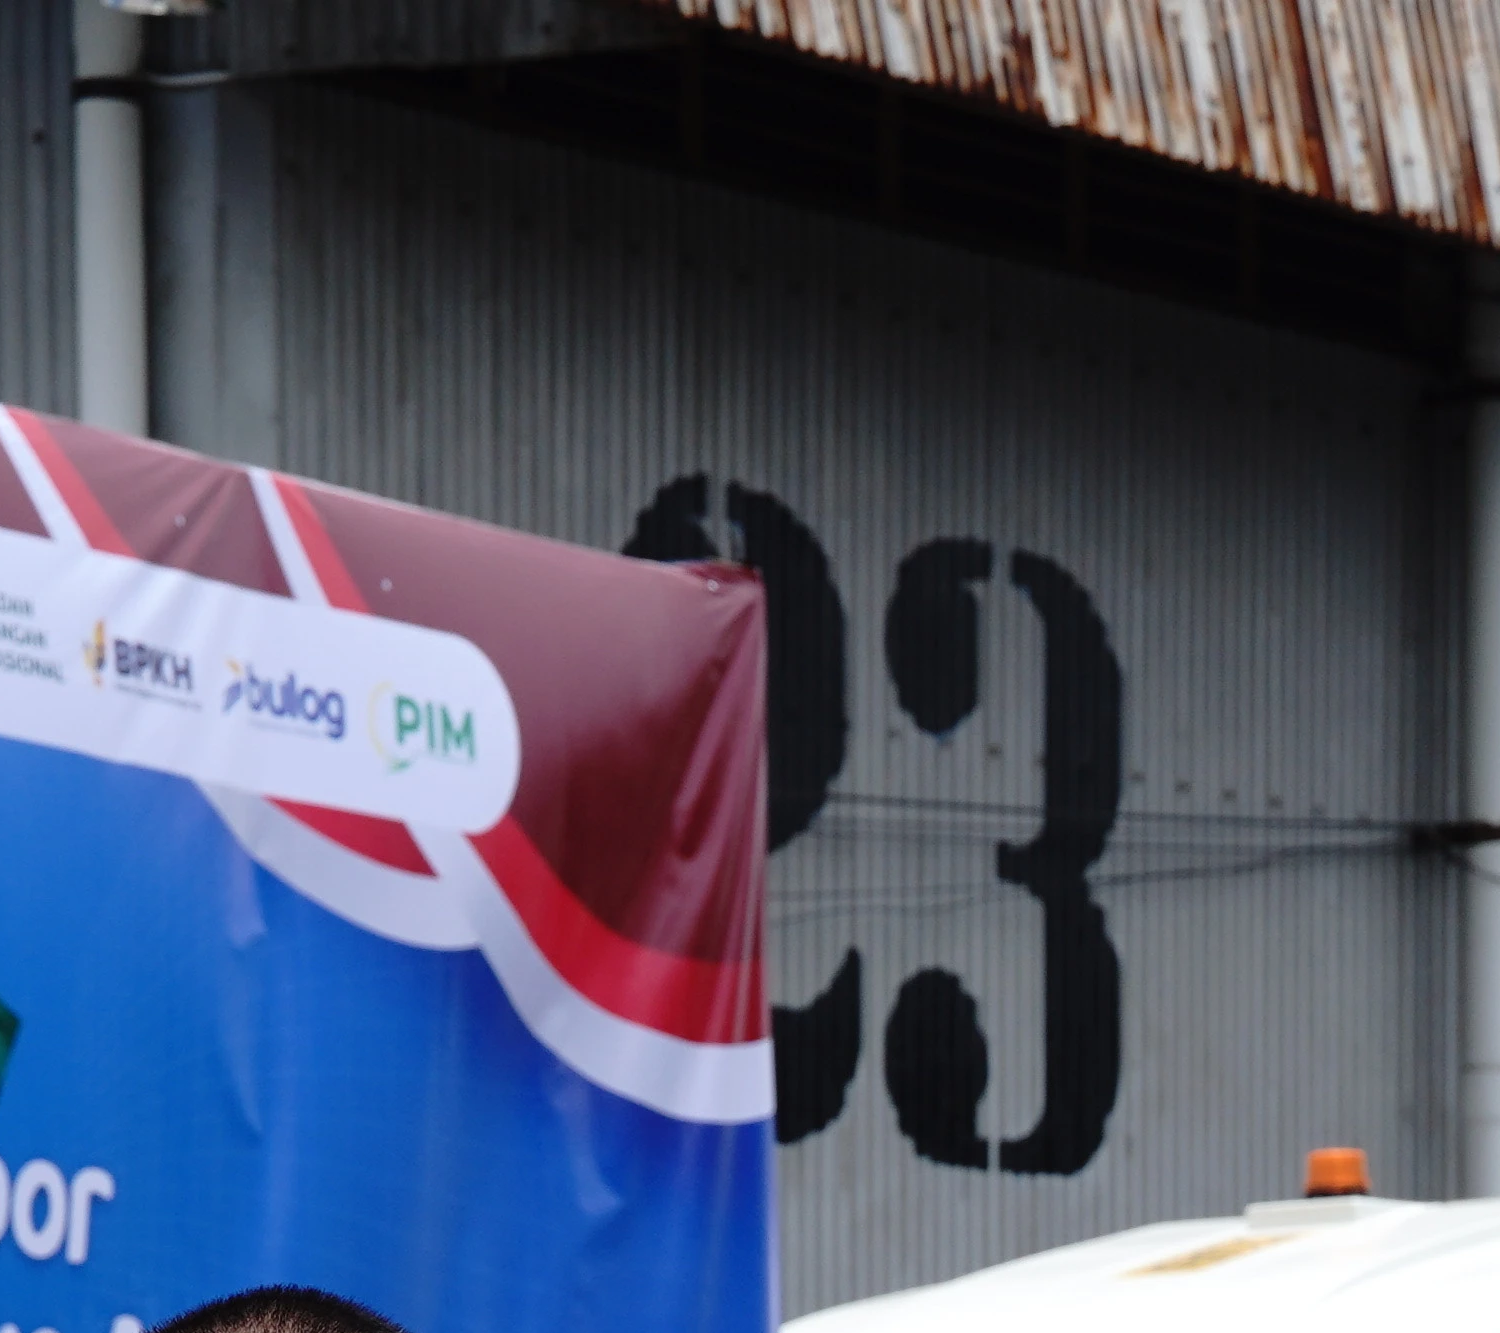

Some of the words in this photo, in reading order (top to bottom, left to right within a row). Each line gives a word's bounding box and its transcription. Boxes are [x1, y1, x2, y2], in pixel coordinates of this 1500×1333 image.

[113, 637, 194, 691] BPKH
[244, 662, 347, 741] bulog
[394, 694, 477, 761] PIM
